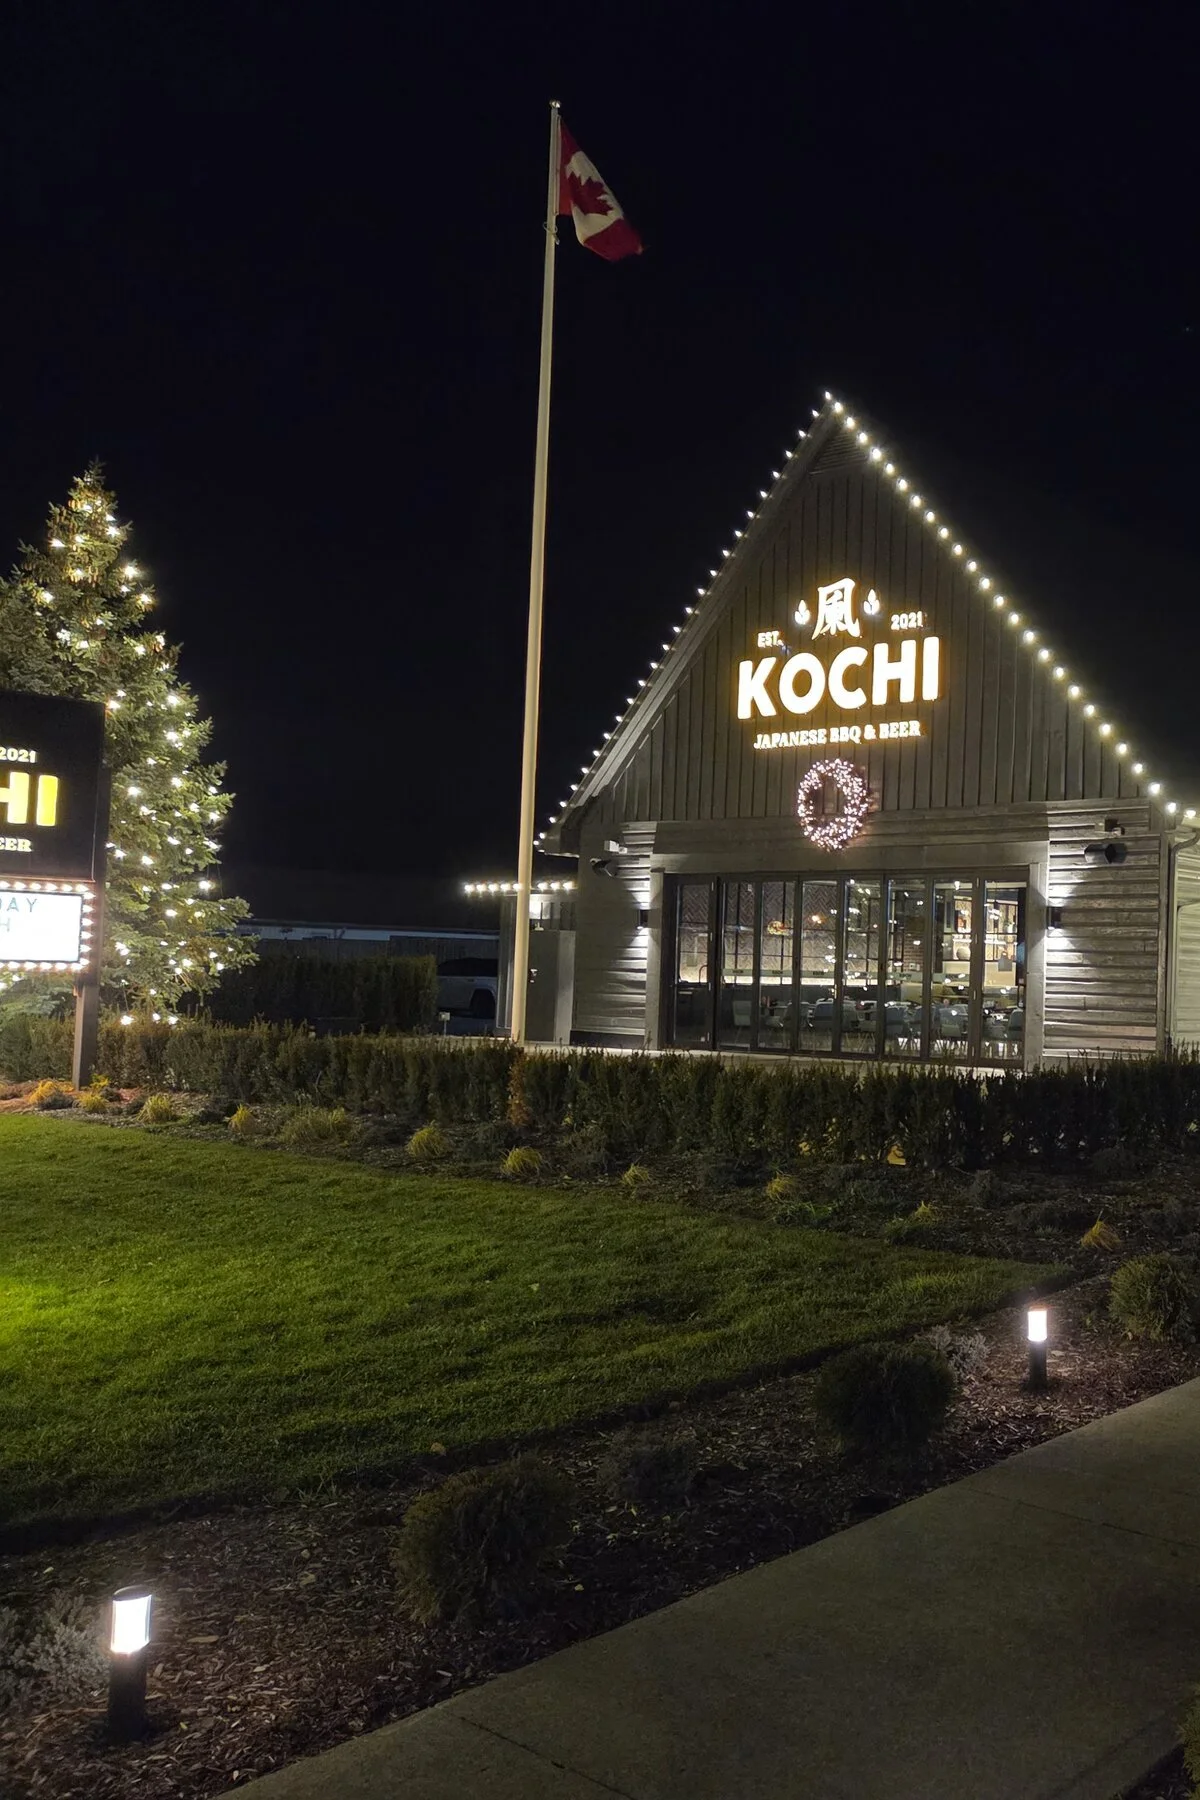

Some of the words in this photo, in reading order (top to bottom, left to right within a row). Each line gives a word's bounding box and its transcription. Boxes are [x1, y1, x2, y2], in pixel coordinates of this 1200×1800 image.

[757, 630, 784, 648] EST.
[890, 611, 924, 630] 2021
[737, 636, 940, 720] KOCHI
[753, 728, 828, 749] JAPANESE
[829, 725, 862, 744] BBQ
[864, 724, 877, 740] &
[879, 720, 922, 739] BEER
[0, 746, 37, 764] 2021
[0, 897, 38, 913] AY
